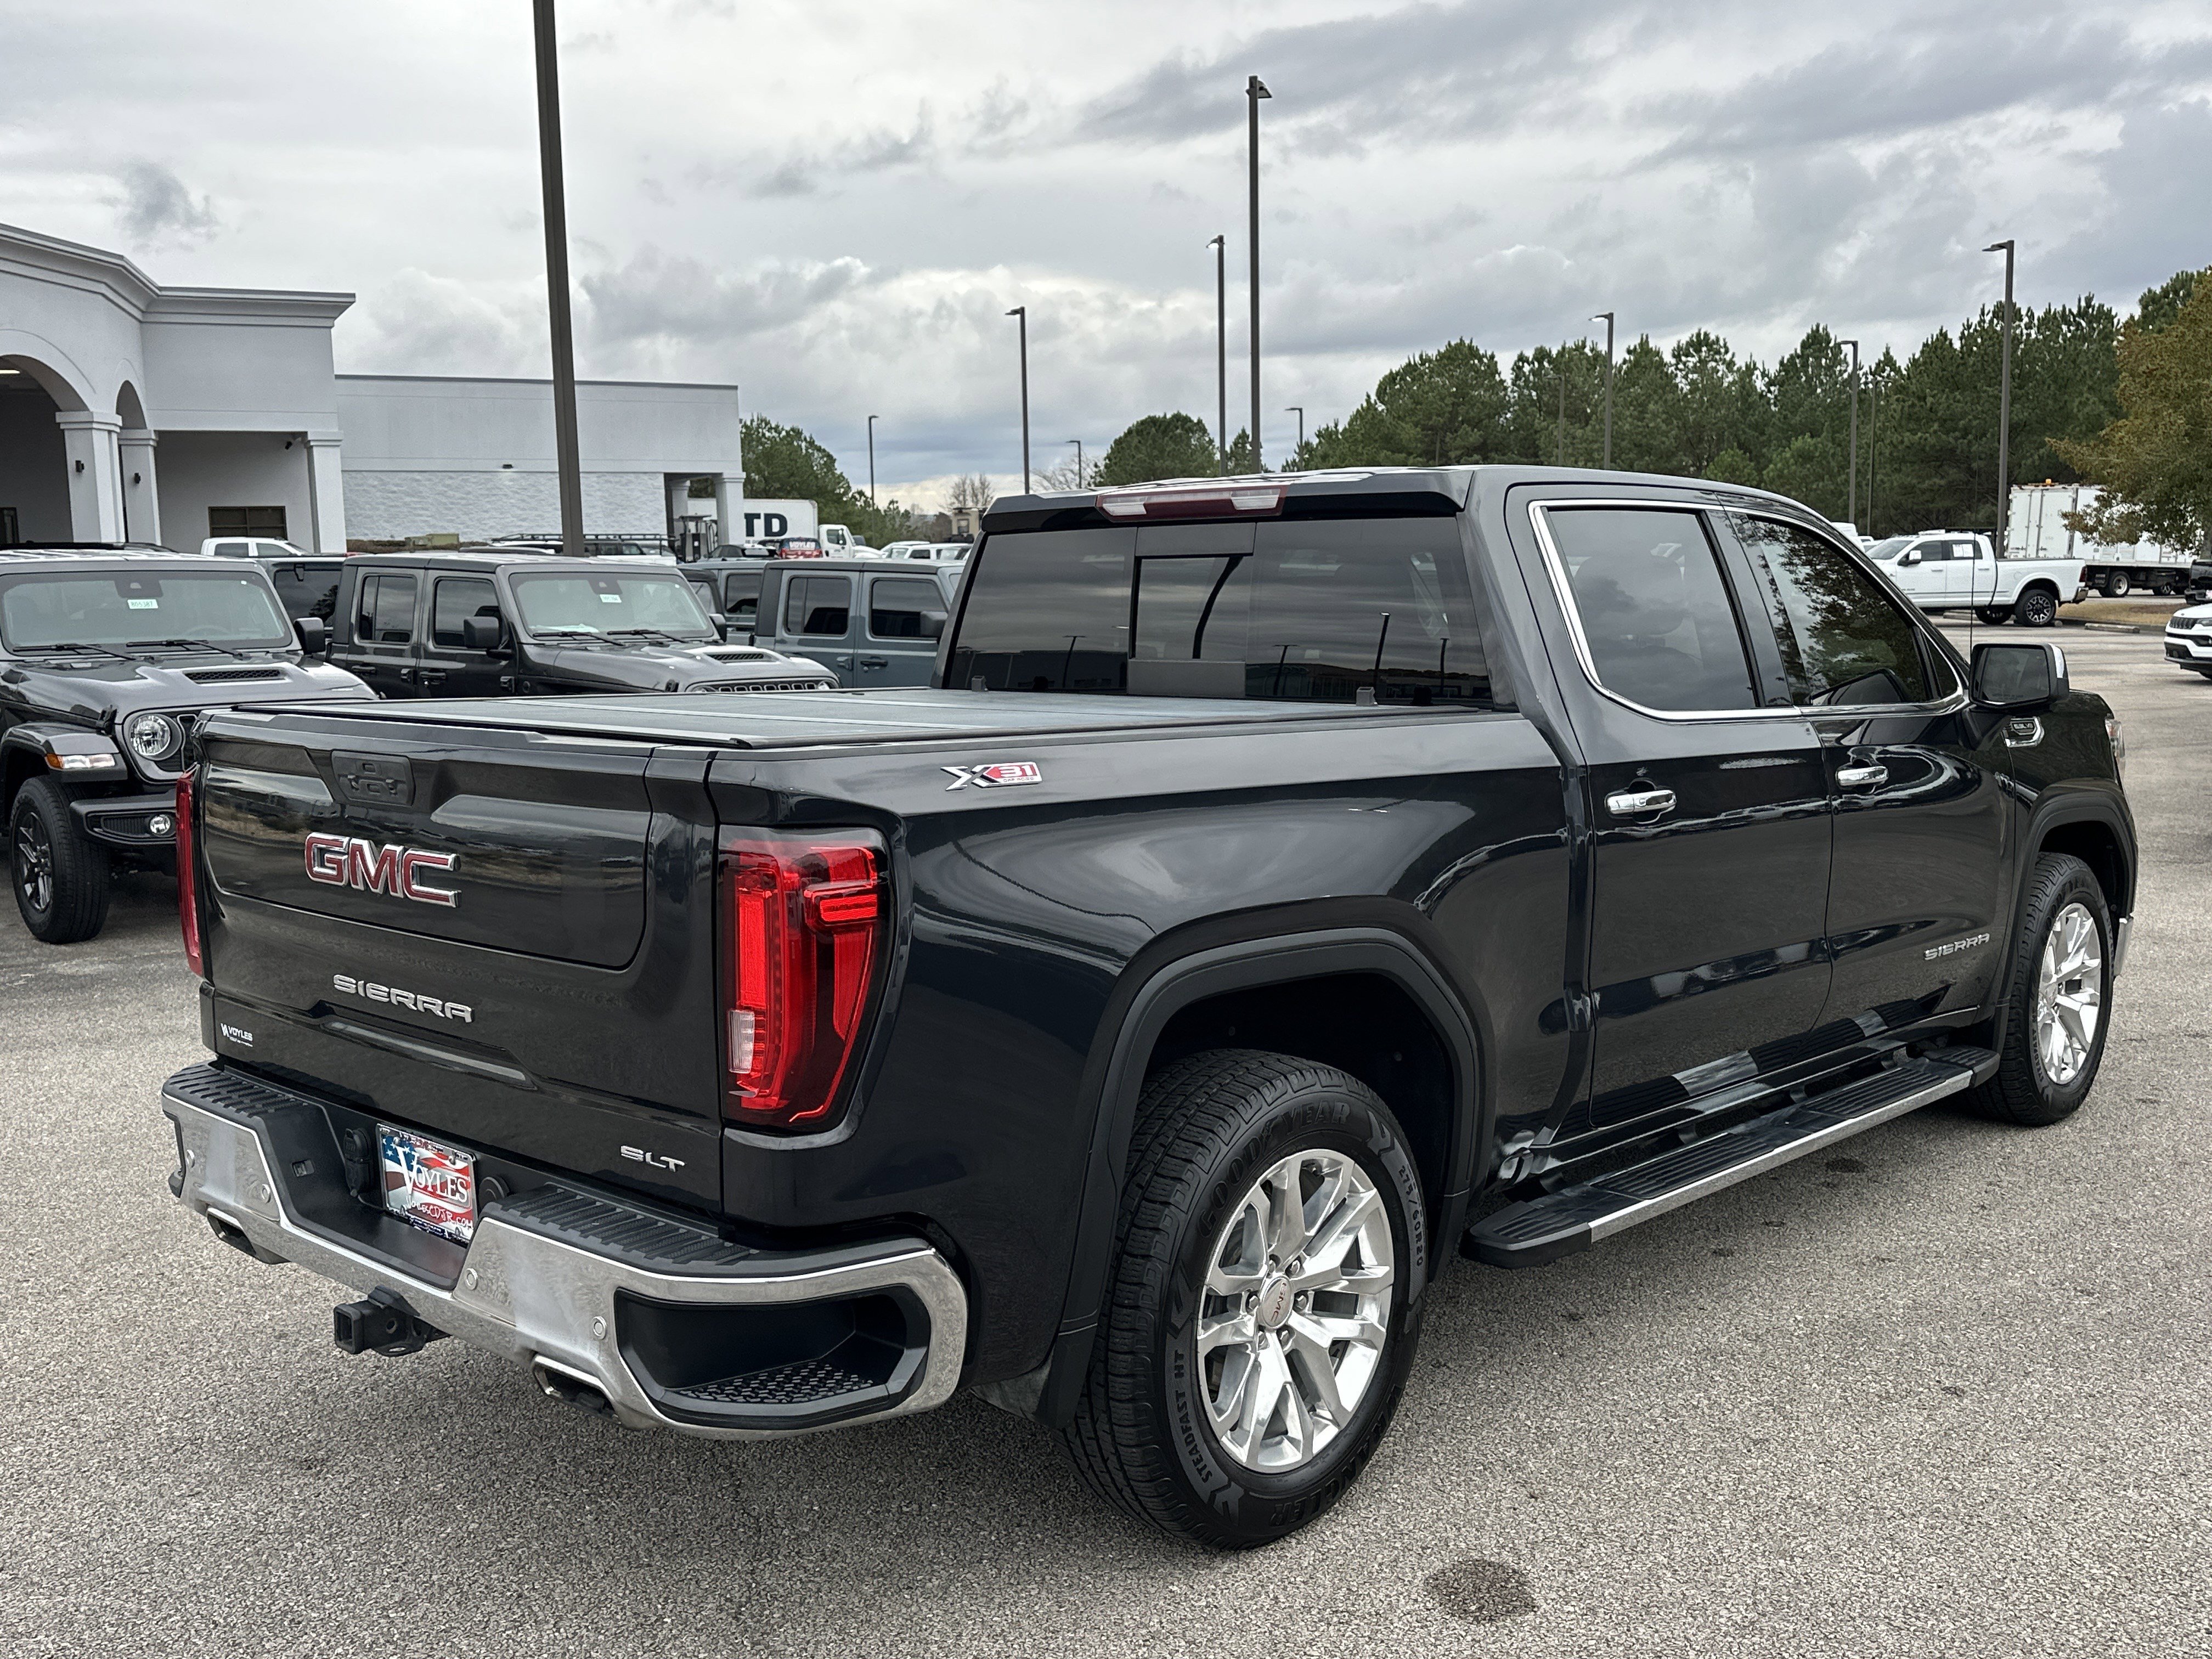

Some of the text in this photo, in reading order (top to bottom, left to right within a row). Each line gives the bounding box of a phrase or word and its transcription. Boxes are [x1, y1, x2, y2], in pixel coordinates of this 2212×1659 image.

[304, 832, 461, 908] GMC
[1924, 933, 1990, 961] SIERRA
[333, 974, 473, 1023] SIERRA
[228, 1025, 253, 1041] VOYLES
[620, 1146, 685, 1172] SLT
[1398, 1165, 1424, 1267] 275/60R20
[1174, 1349, 1213, 1483] STEADFAST HT
